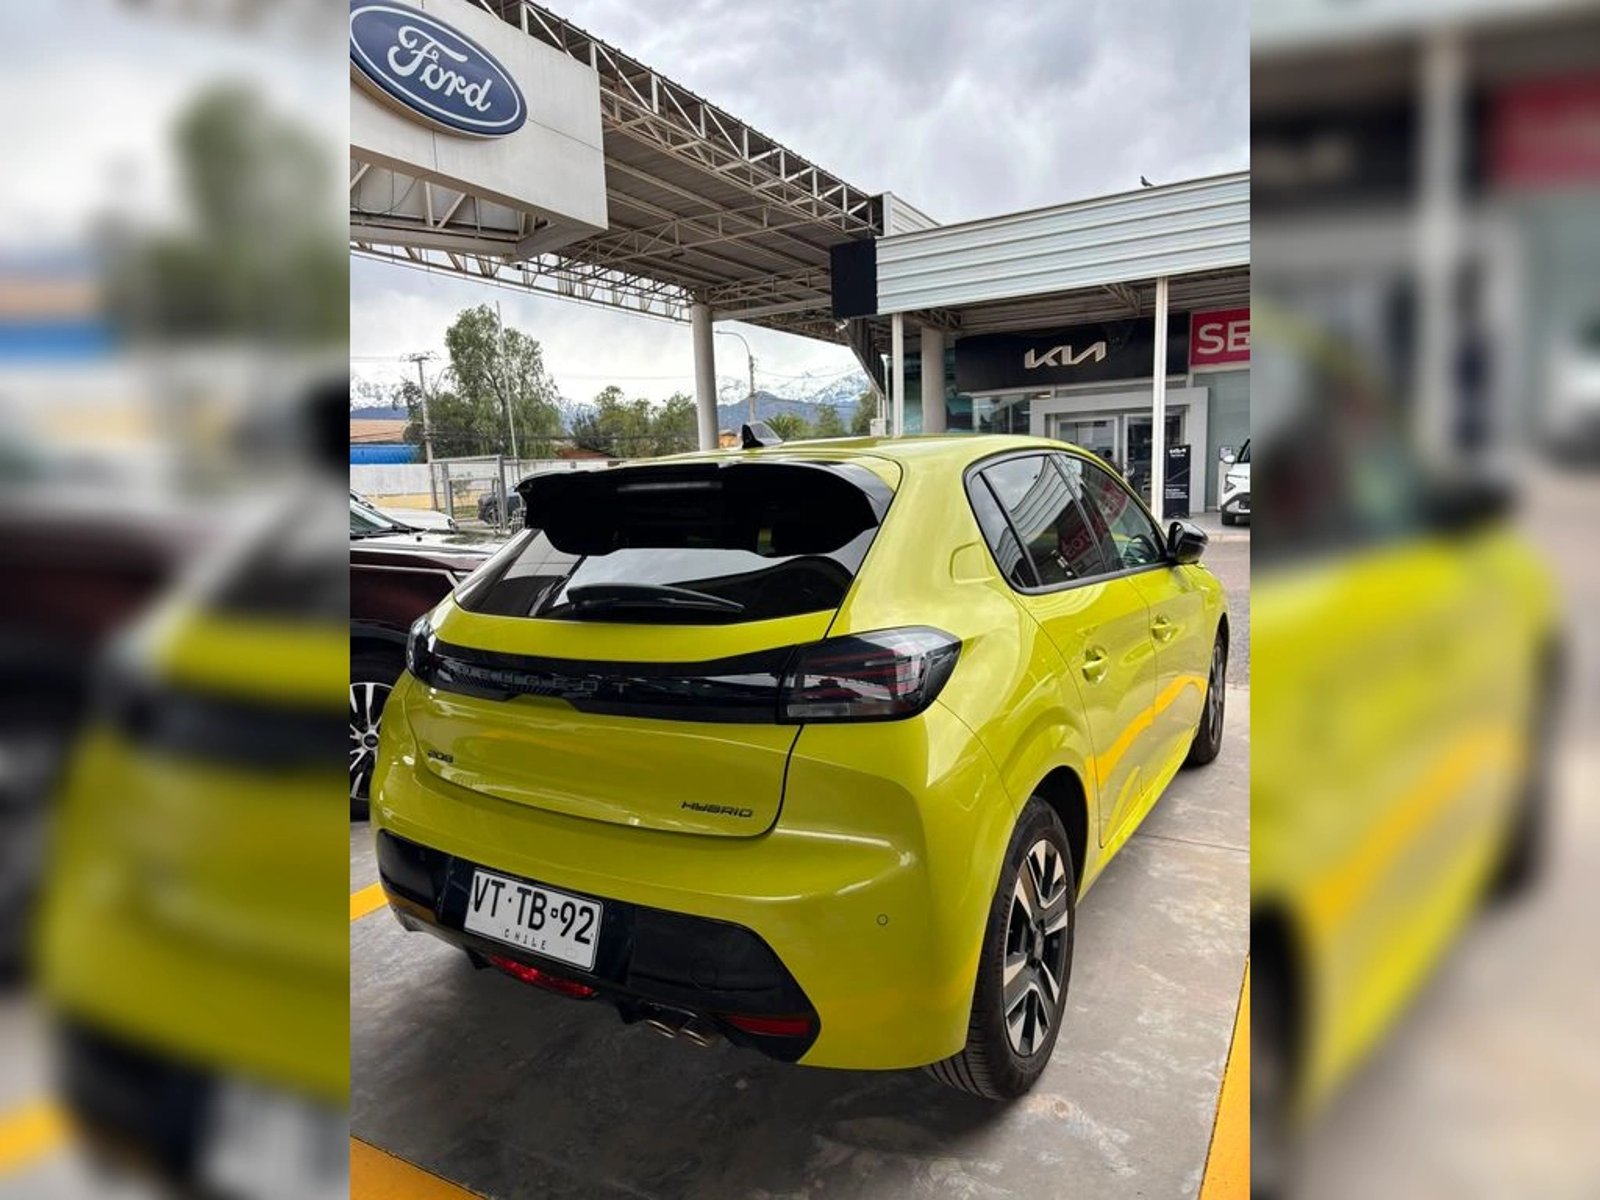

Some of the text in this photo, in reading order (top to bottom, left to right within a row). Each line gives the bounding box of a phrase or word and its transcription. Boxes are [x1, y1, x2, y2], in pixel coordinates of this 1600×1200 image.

[387, 25, 492, 112] Ford
[1024, 341, 1107, 369] KIA
[681, 801, 753, 818] HYBRID
[504, 928, 547, 950] CHILE
